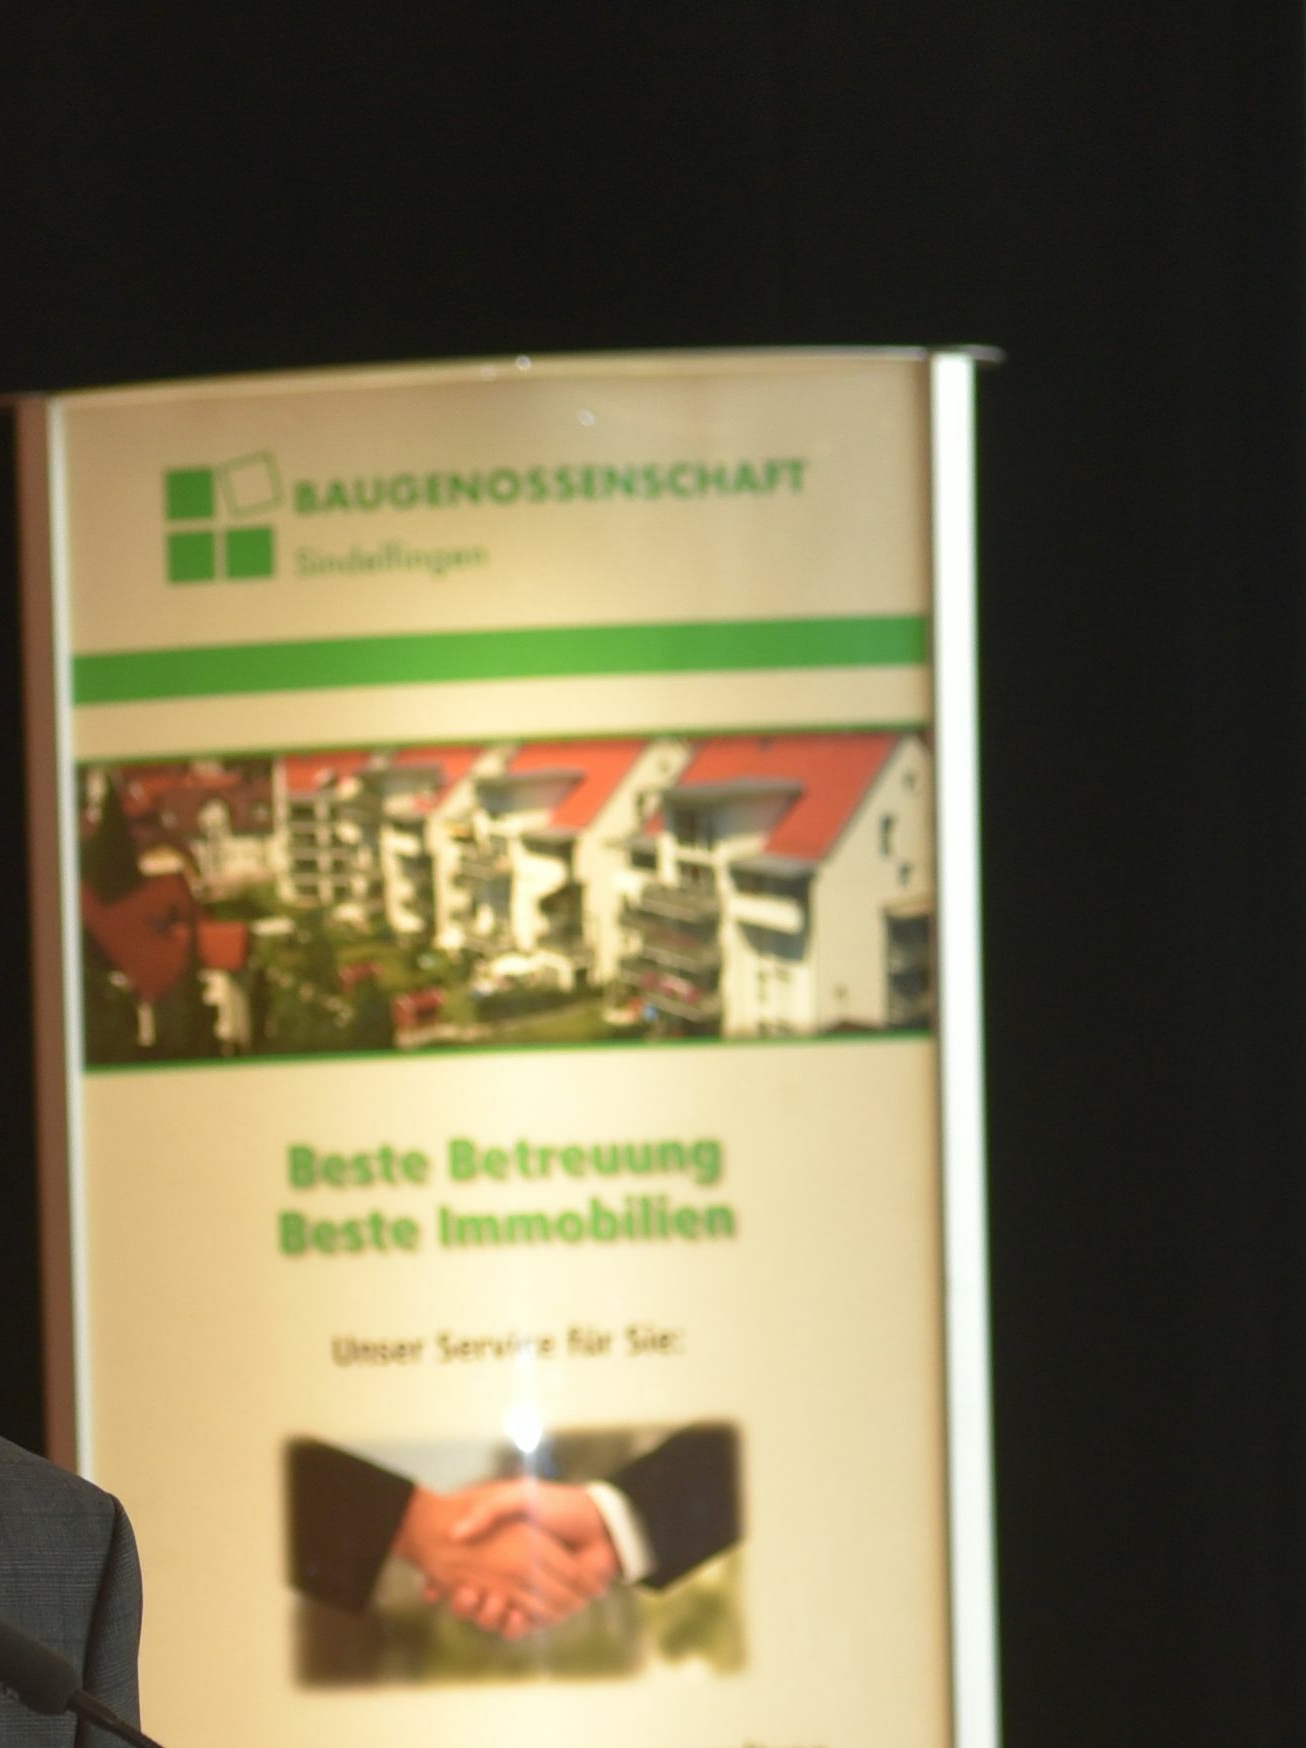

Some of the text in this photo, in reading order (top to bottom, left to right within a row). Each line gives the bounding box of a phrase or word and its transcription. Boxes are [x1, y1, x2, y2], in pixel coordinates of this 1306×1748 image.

[293, 455, 808, 515] BAUGENOSSENSCHAFT
[294, 541, 489, 581] Sindelfingen
[287, 1137, 723, 1189] Beste Betreuung
[280, 1196, 738, 1256] Beste Immobilien
[332, 1333, 422, 1367] Unser
[568, 1324, 610, 1357] für
